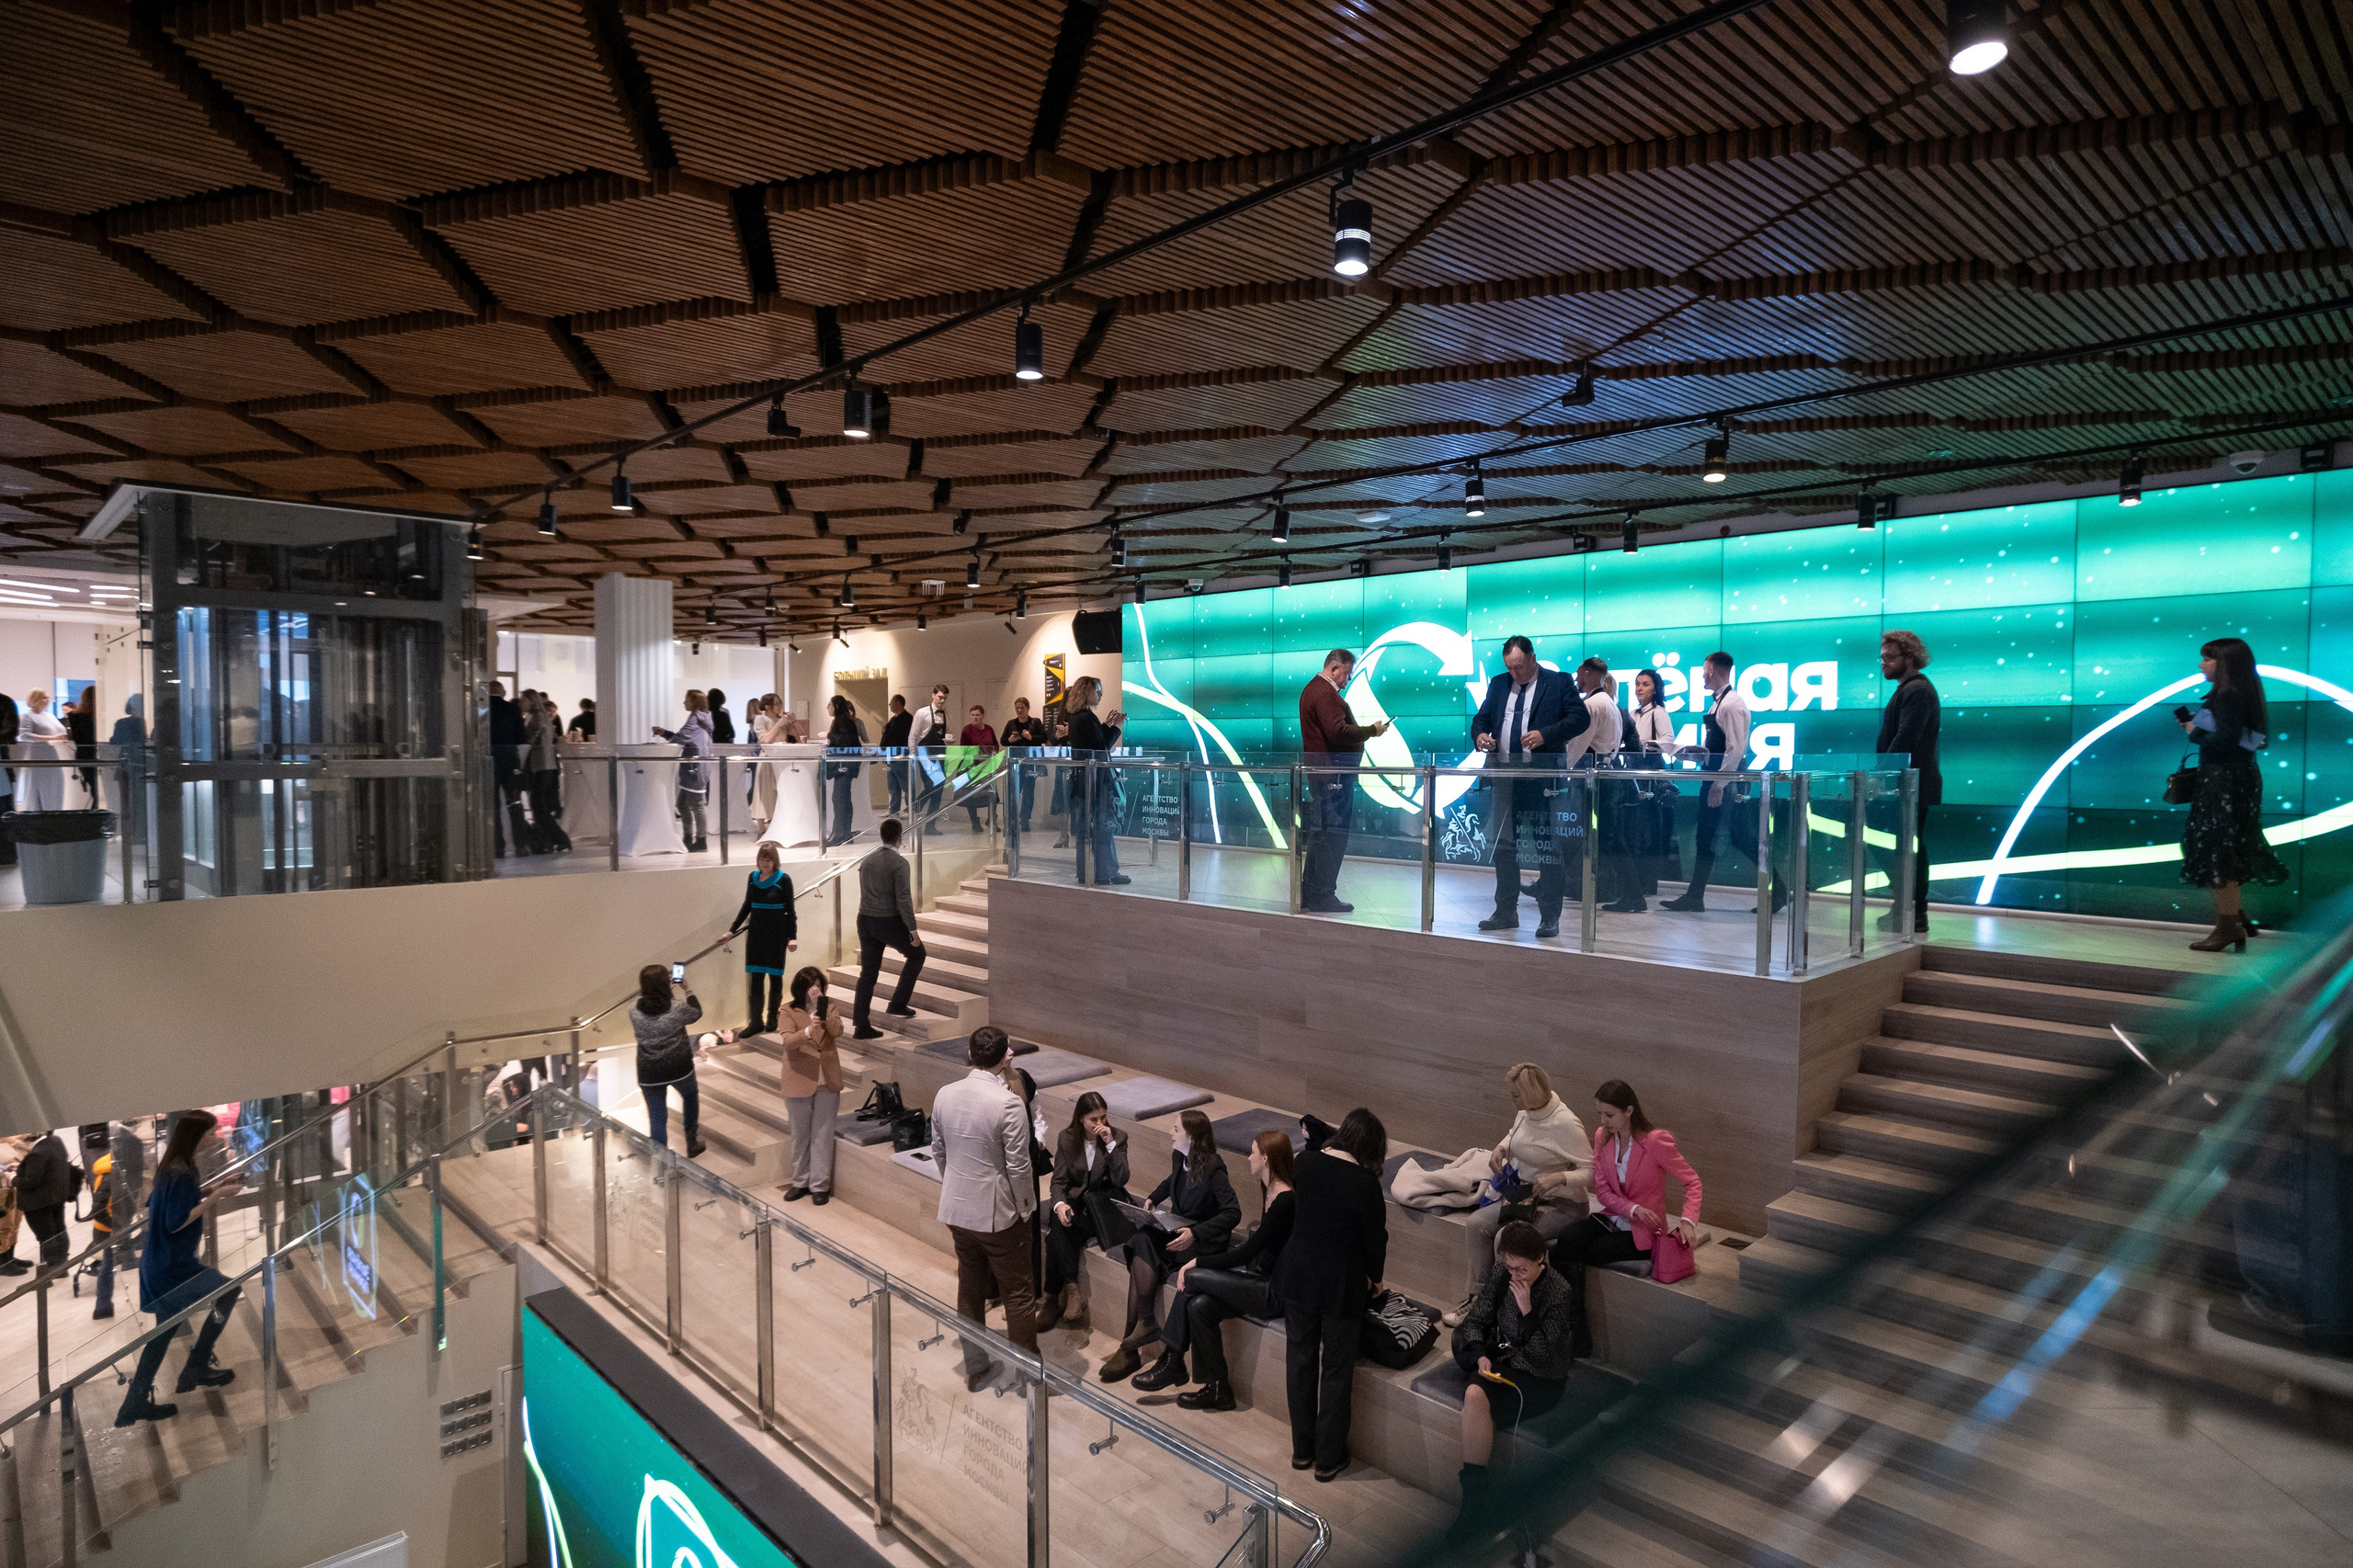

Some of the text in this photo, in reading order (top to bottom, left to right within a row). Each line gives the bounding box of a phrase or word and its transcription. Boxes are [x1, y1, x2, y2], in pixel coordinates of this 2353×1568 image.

[1537, 652, 1838, 713] лёная
[1142, 794, 1178, 804] АГЕТСТВО
[1142, 805, 1181, 816] ИННОВАЦИЙ
[1516, 810, 1578, 823] АГЕНТСТВО
[1142, 816, 1168, 826] ГОРОДА
[1142, 827, 1169, 836] МОСКВЫ
[1516, 824, 1584, 838] ИННОВАЦИЙ
[1516, 838, 1560, 852] ГОРОДА
[1516, 853, 1564, 865] МОСКВЫ
[962, 1403, 1023, 1451] АГЕНТСТВО
[962, 1443, 1005, 1483] ГОРОДА
[963, 1464, 1009, 1506] МОСКВЫ
